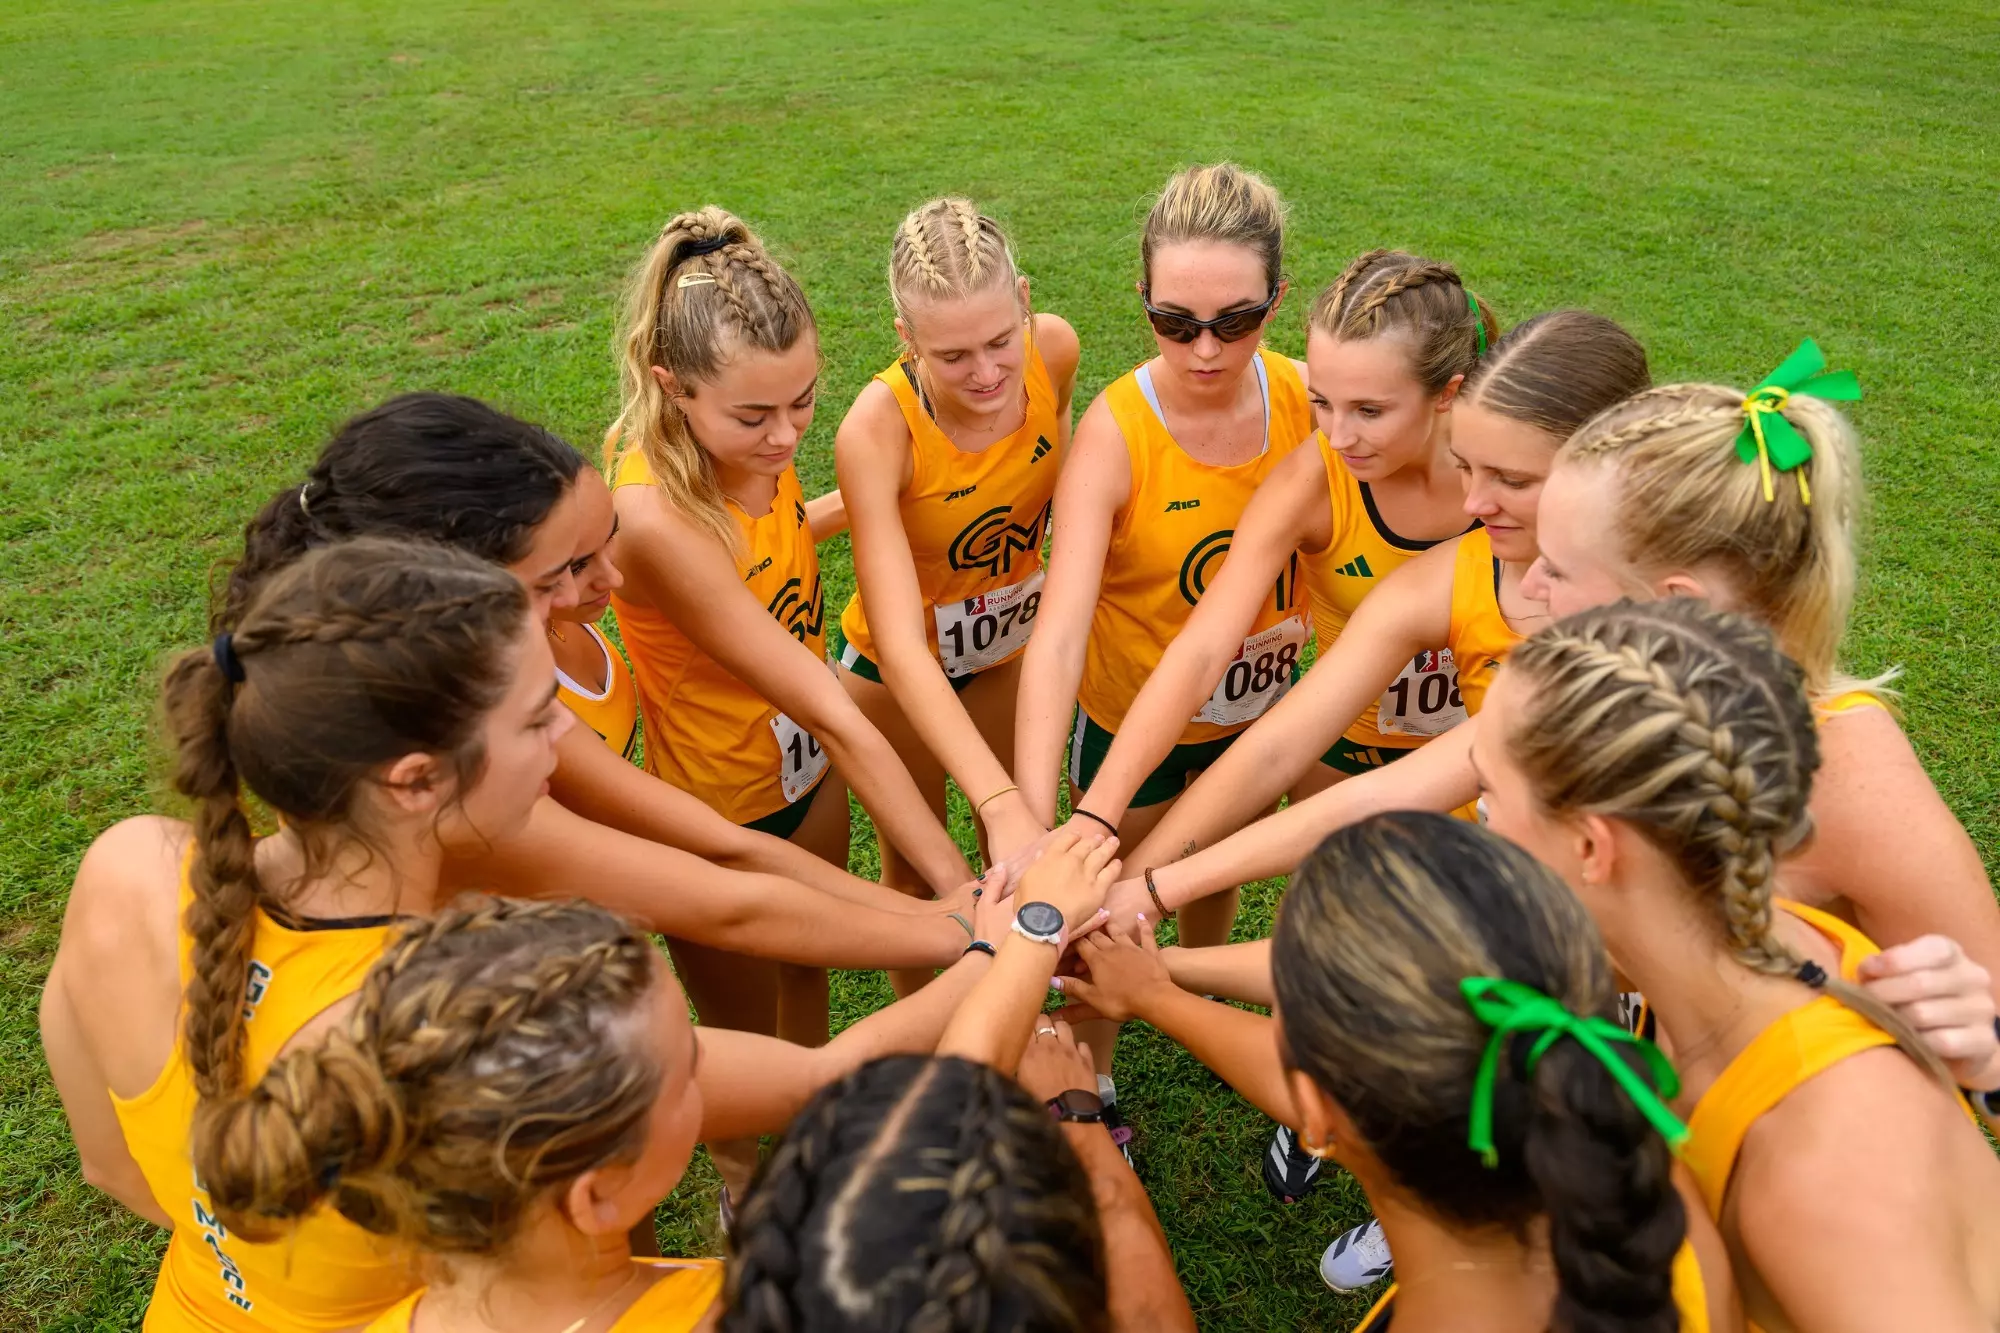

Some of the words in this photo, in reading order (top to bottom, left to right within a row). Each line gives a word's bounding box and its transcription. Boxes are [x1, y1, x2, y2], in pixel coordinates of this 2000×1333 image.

[1164, 499, 1200, 513] A10
[945, 591, 1042, 658] 1078
[1246, 633, 1283, 652] RUNNING
[1225, 642, 1298, 702] 088
[1388, 670, 1465, 716] 108
[787, 732, 821, 773] 10
